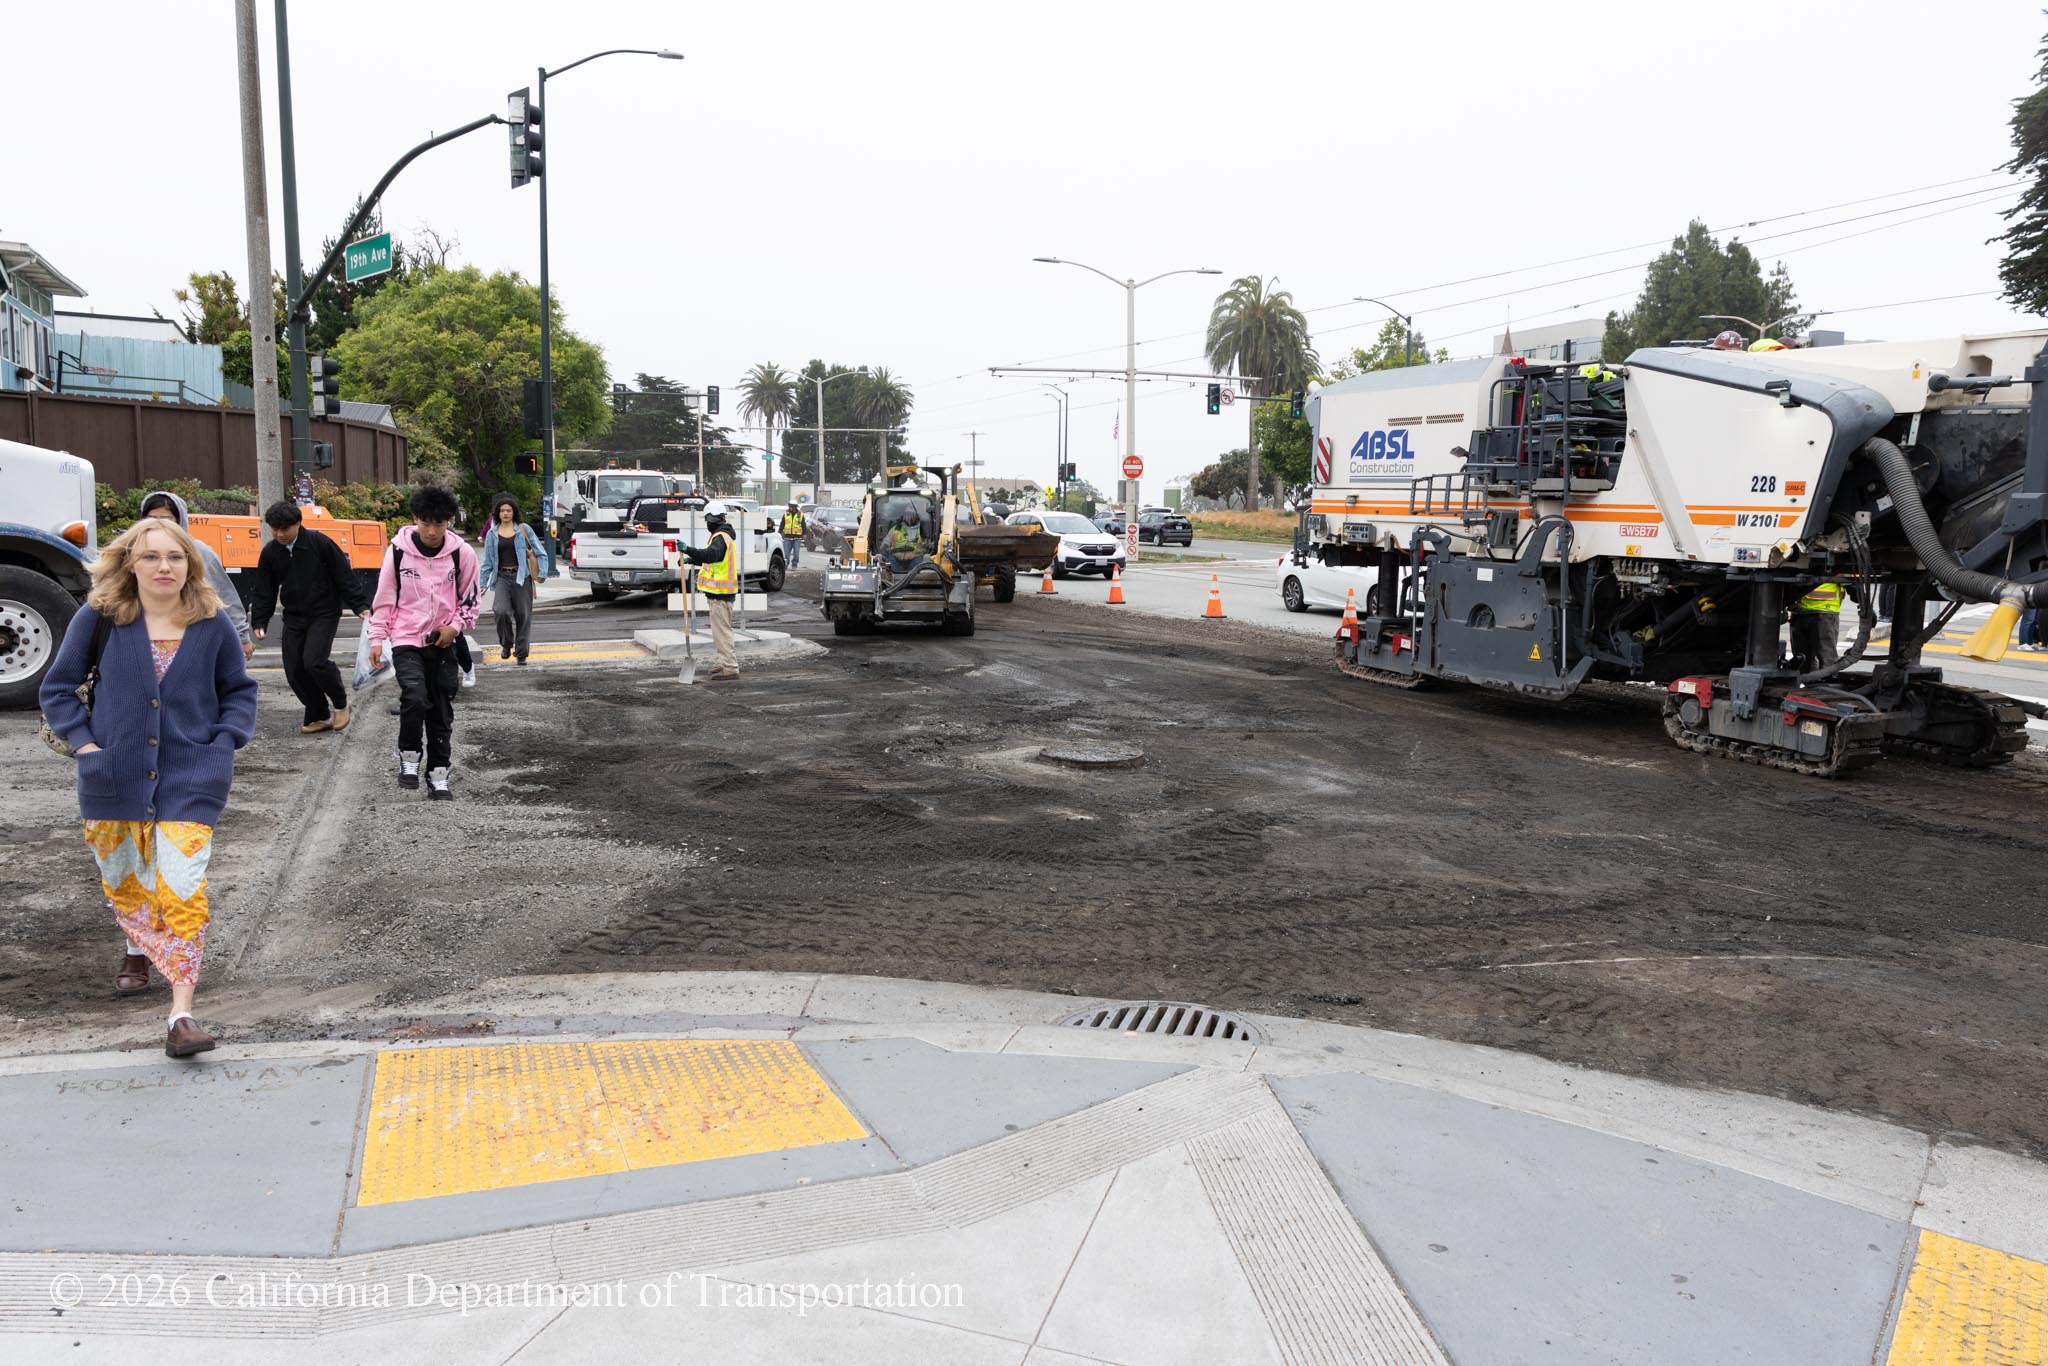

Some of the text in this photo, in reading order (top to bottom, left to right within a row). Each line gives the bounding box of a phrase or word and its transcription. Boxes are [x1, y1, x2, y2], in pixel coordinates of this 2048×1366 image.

[350, 247, 387, 269] 19th Ave
[1351, 429, 1415, 460] ABSL
[1349, 461, 1414, 474] Construction
[1751, 475, 1776, 493] 228
[1737, 514, 1749, 527] W
[56, 1064, 309, 1094] HOLLOWAY
